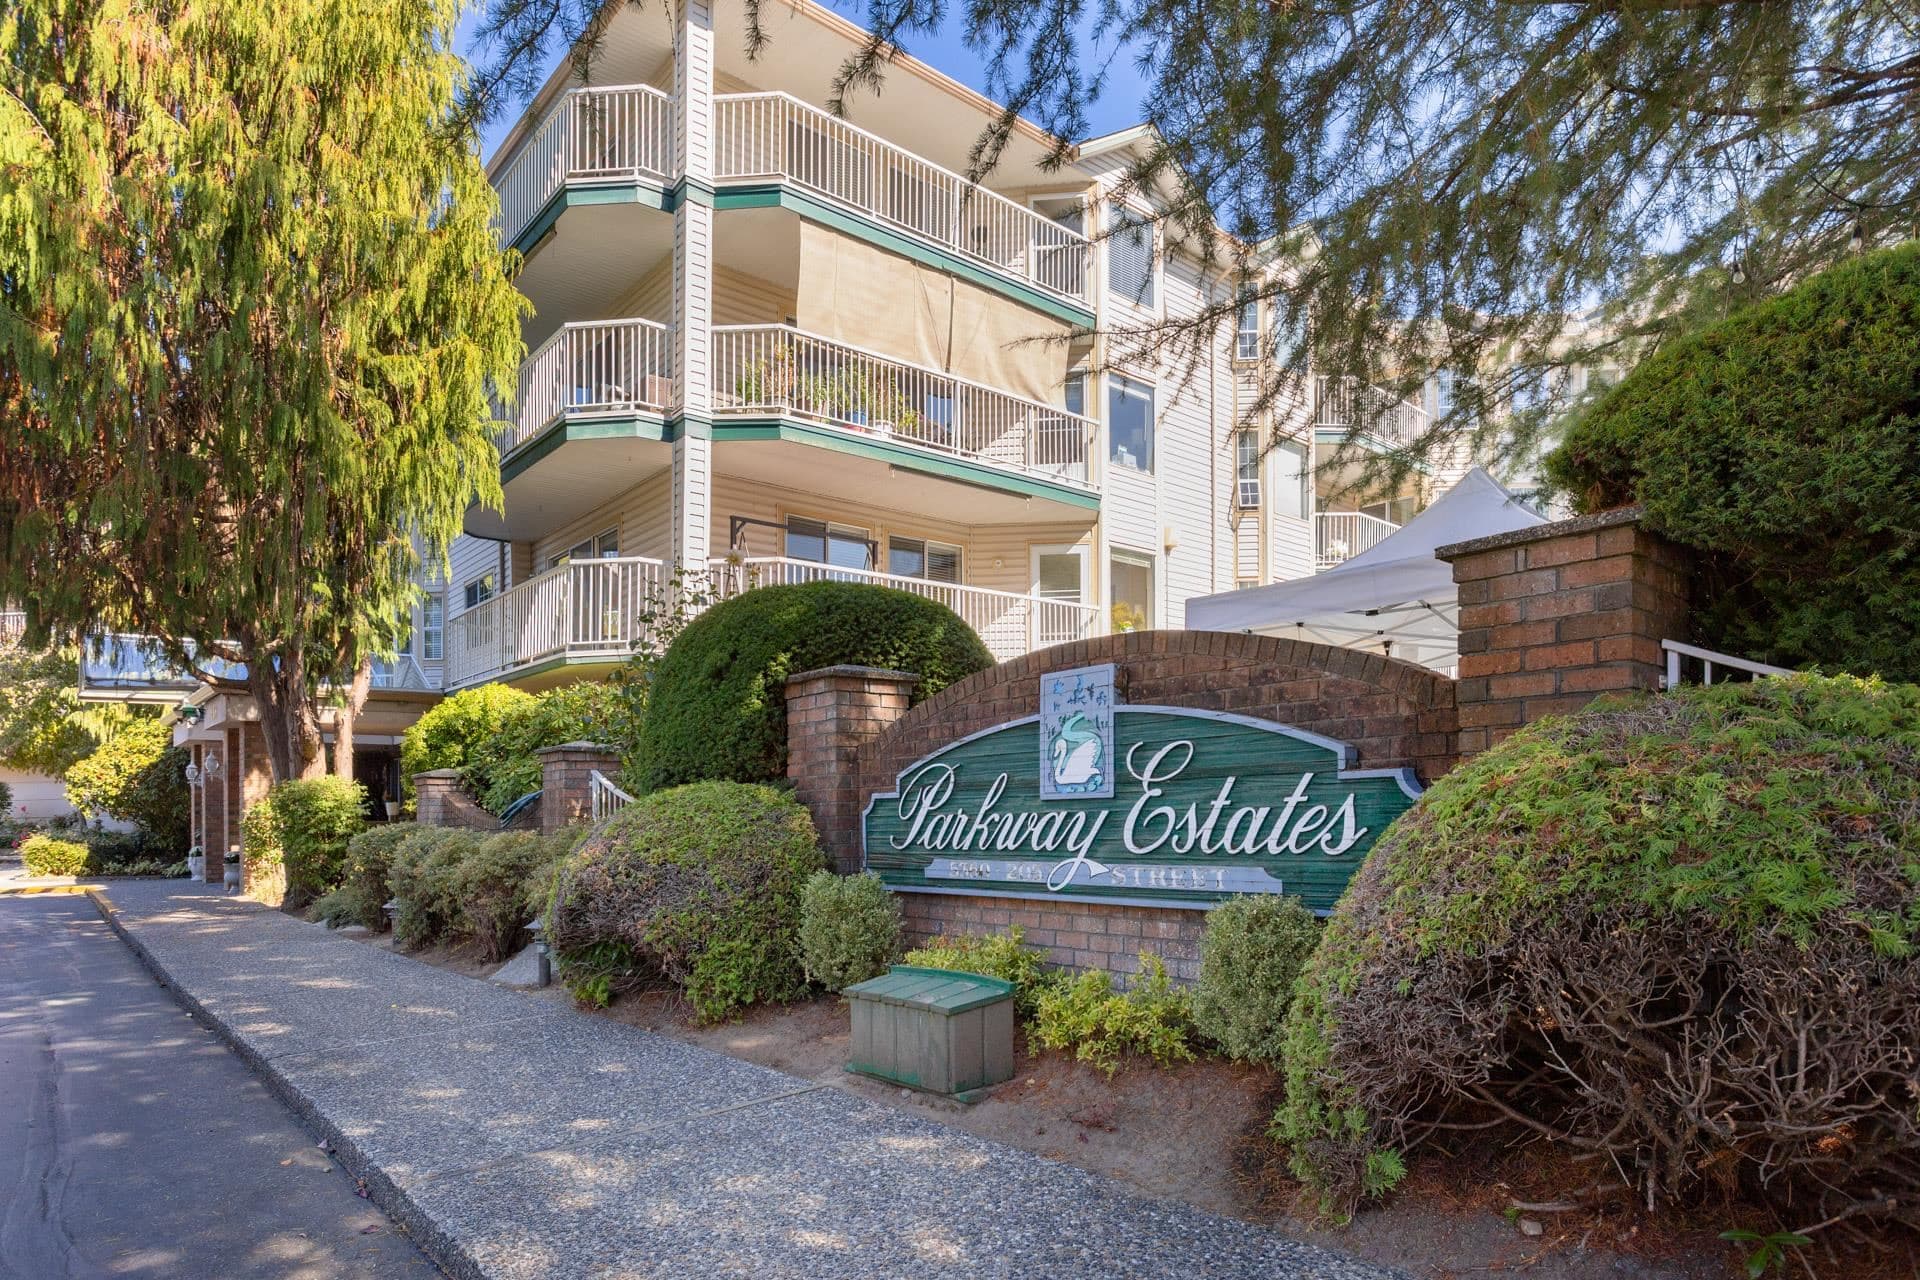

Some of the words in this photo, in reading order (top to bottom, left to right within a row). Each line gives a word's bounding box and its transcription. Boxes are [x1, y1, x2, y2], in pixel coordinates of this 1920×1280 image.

[890, 763, 1109, 891] Parkway
[1123, 740, 1368, 856] Estates
[1111, 866, 1229, 889] STREET
